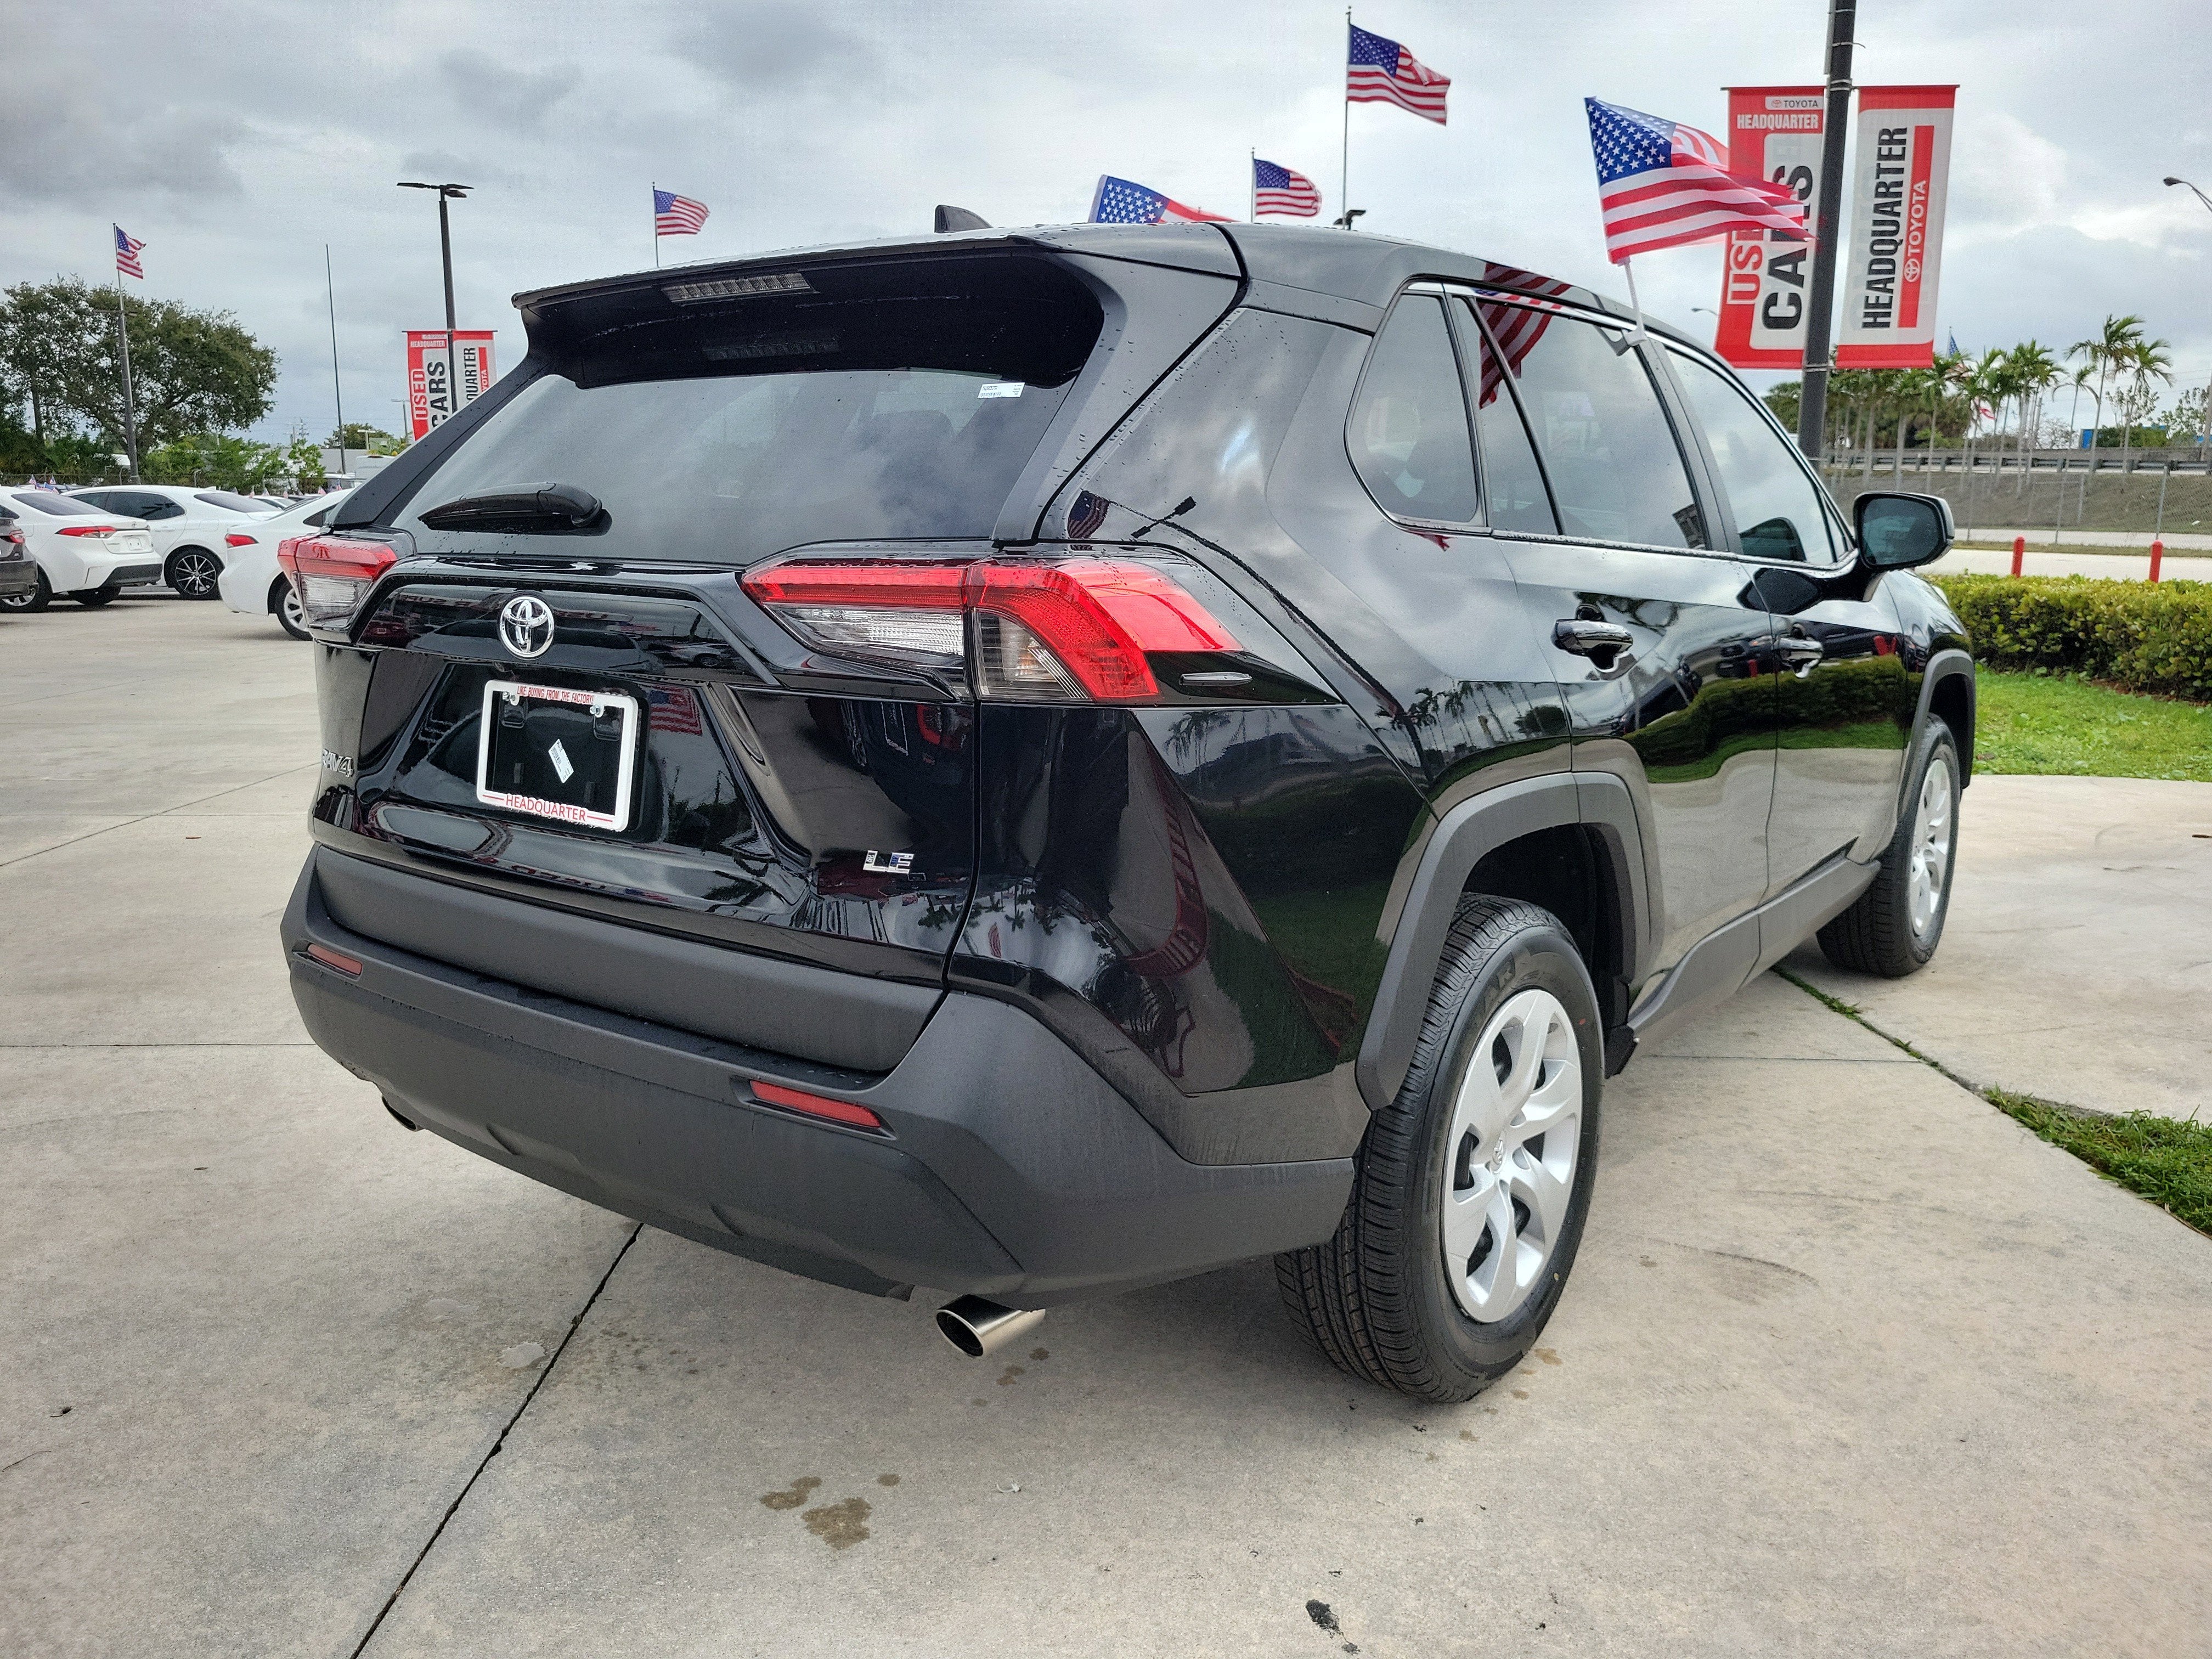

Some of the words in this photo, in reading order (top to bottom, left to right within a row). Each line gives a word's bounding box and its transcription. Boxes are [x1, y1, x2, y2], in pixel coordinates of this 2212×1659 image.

[1784, 100, 1819, 108] TOYOTA
[1737, 114, 1819, 131] HEADQUARTER
[1861, 127, 1908, 329] HEADQUARTER
[1907, 180, 1927, 257] TOYOTA
[464, 347, 478, 401] QUARTER
[411, 369, 429, 420] USED
[517, 686, 526, 695] LIKE
[528, 687, 544, 698] BUYING
[546, 689, 559, 699] FROM
[561, 691, 569, 701] THE
[572, 693, 595, 704] FACTORY!
[506, 794, 586, 821] HEADQUARTER
[862, 850, 915, 874] LE
